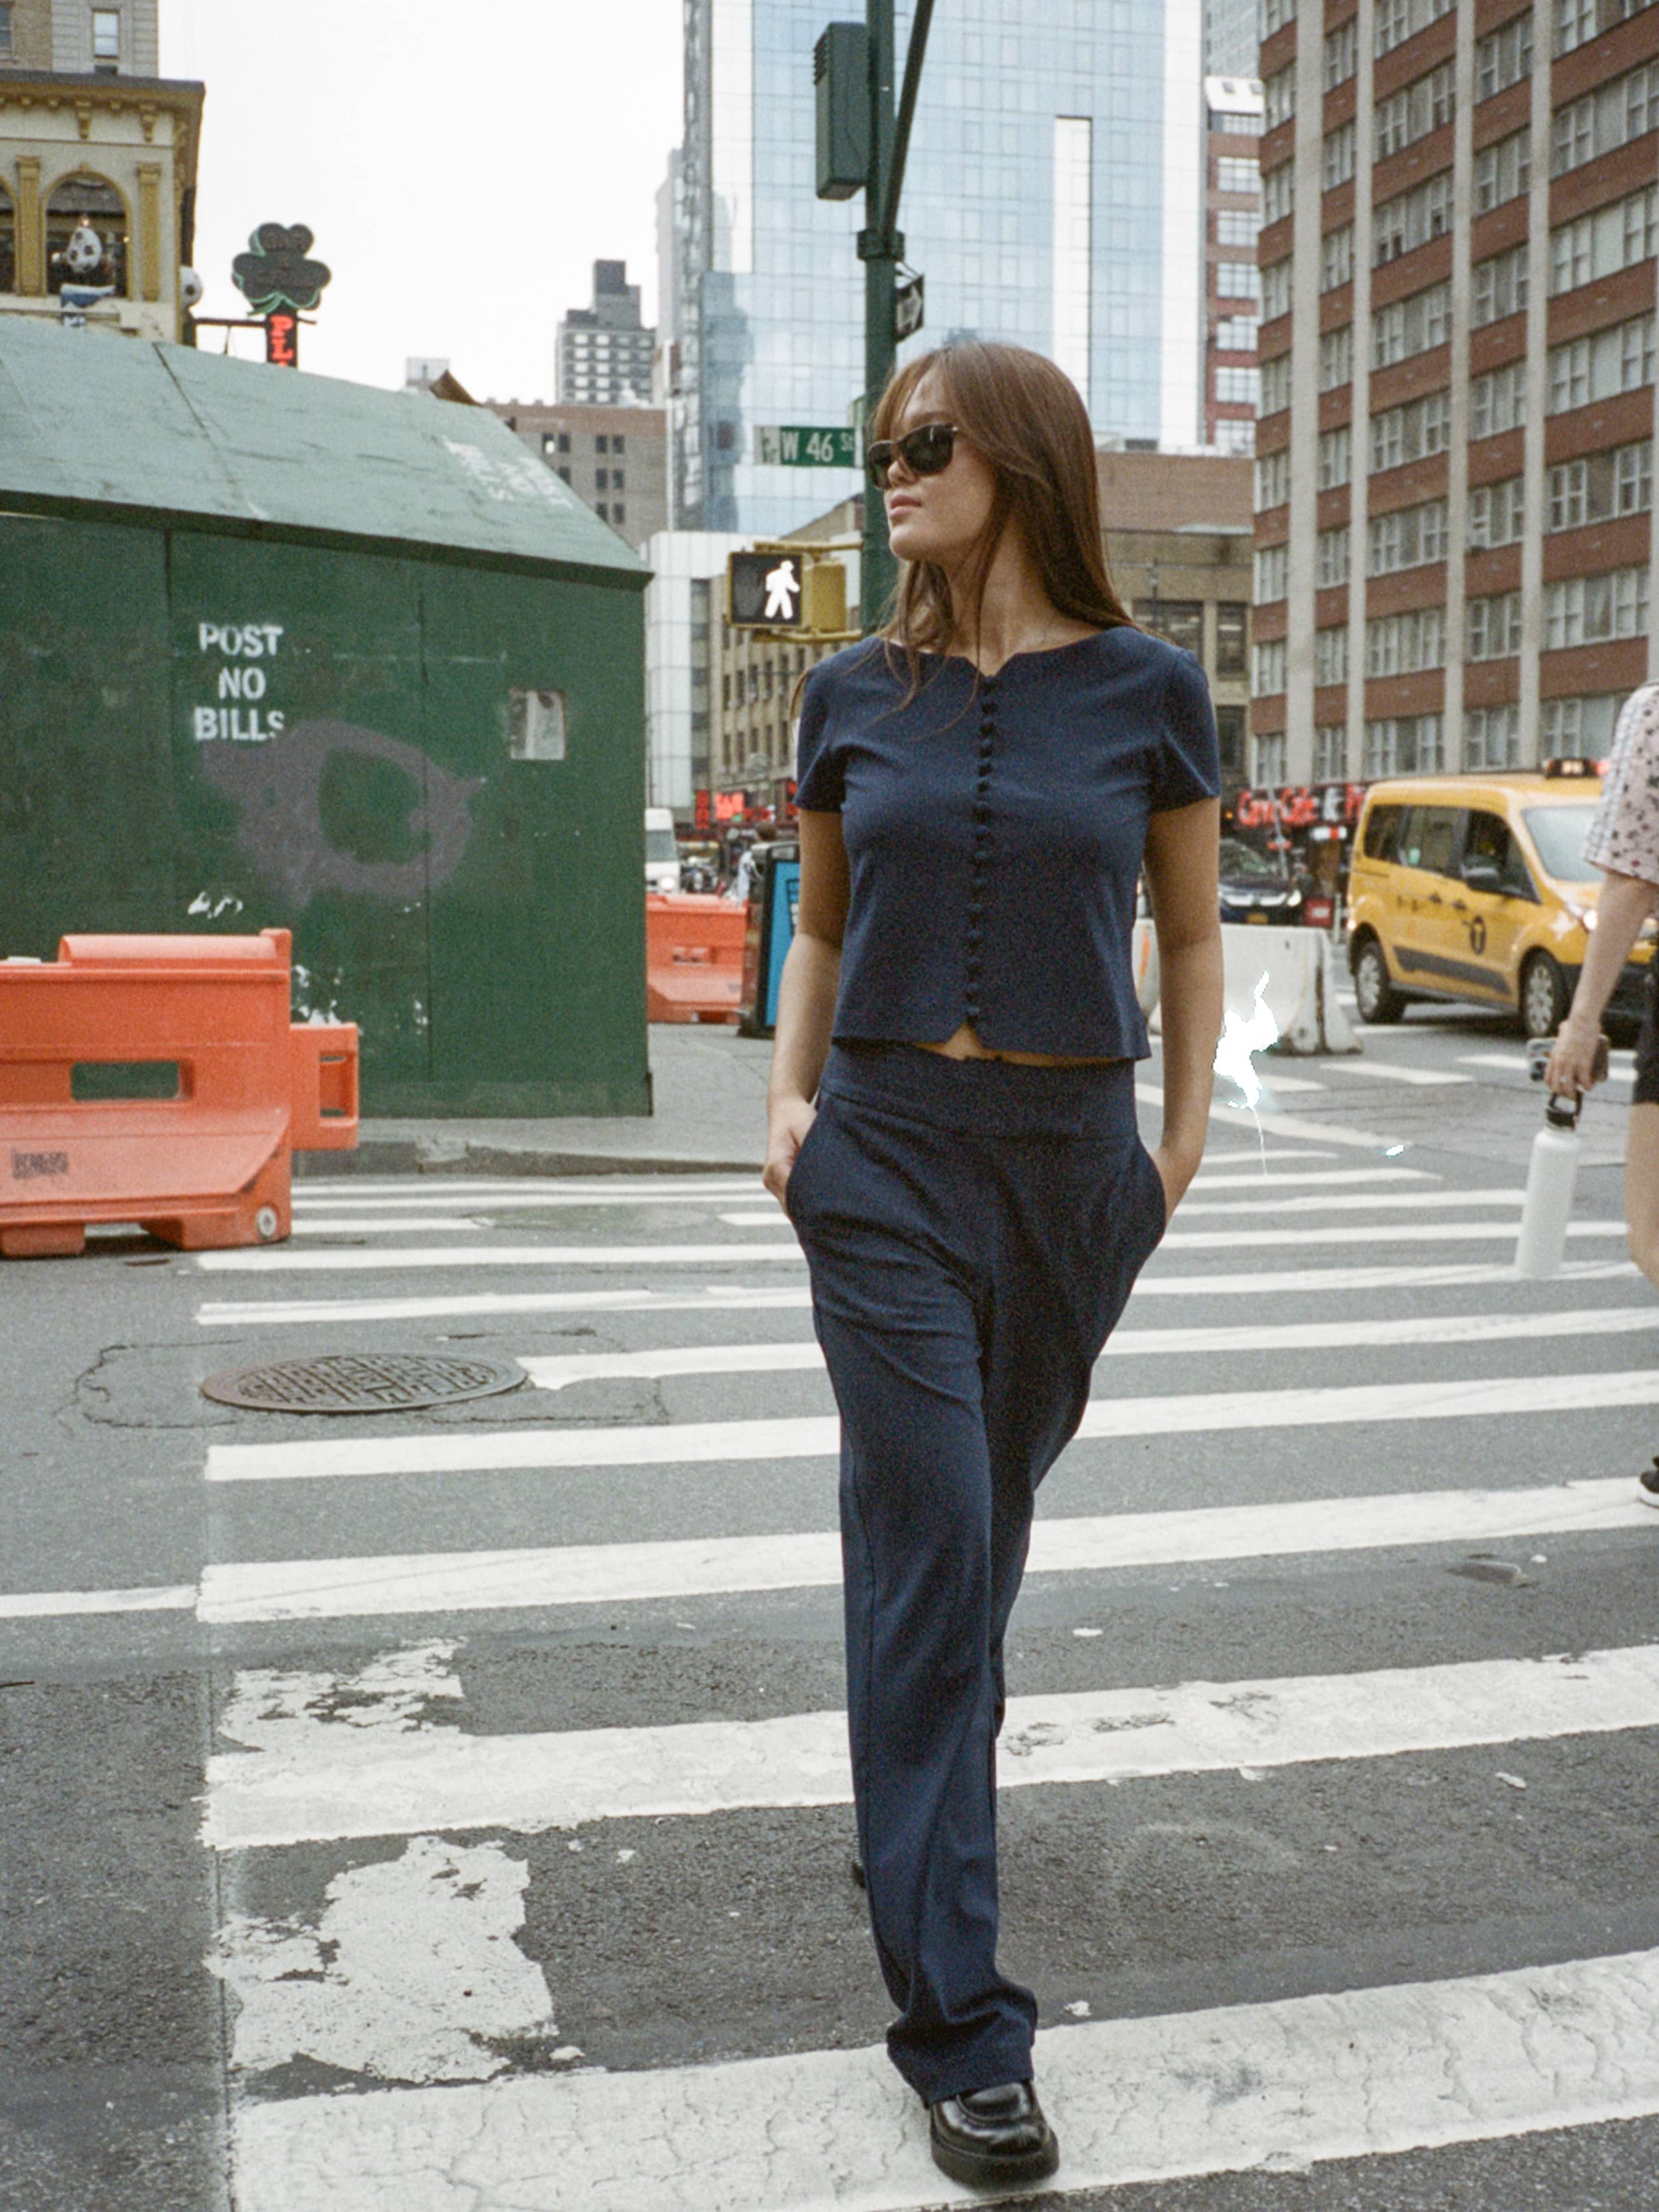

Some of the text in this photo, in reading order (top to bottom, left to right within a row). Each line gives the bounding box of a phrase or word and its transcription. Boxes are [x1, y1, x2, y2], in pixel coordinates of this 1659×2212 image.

[269, 315, 294, 367] PL
[782, 431, 800, 461] W
[806, 431, 833, 462] 46
[200, 623, 283, 658] POST
[219, 666, 266, 700] NO
[194, 706, 285, 741] BILLS
